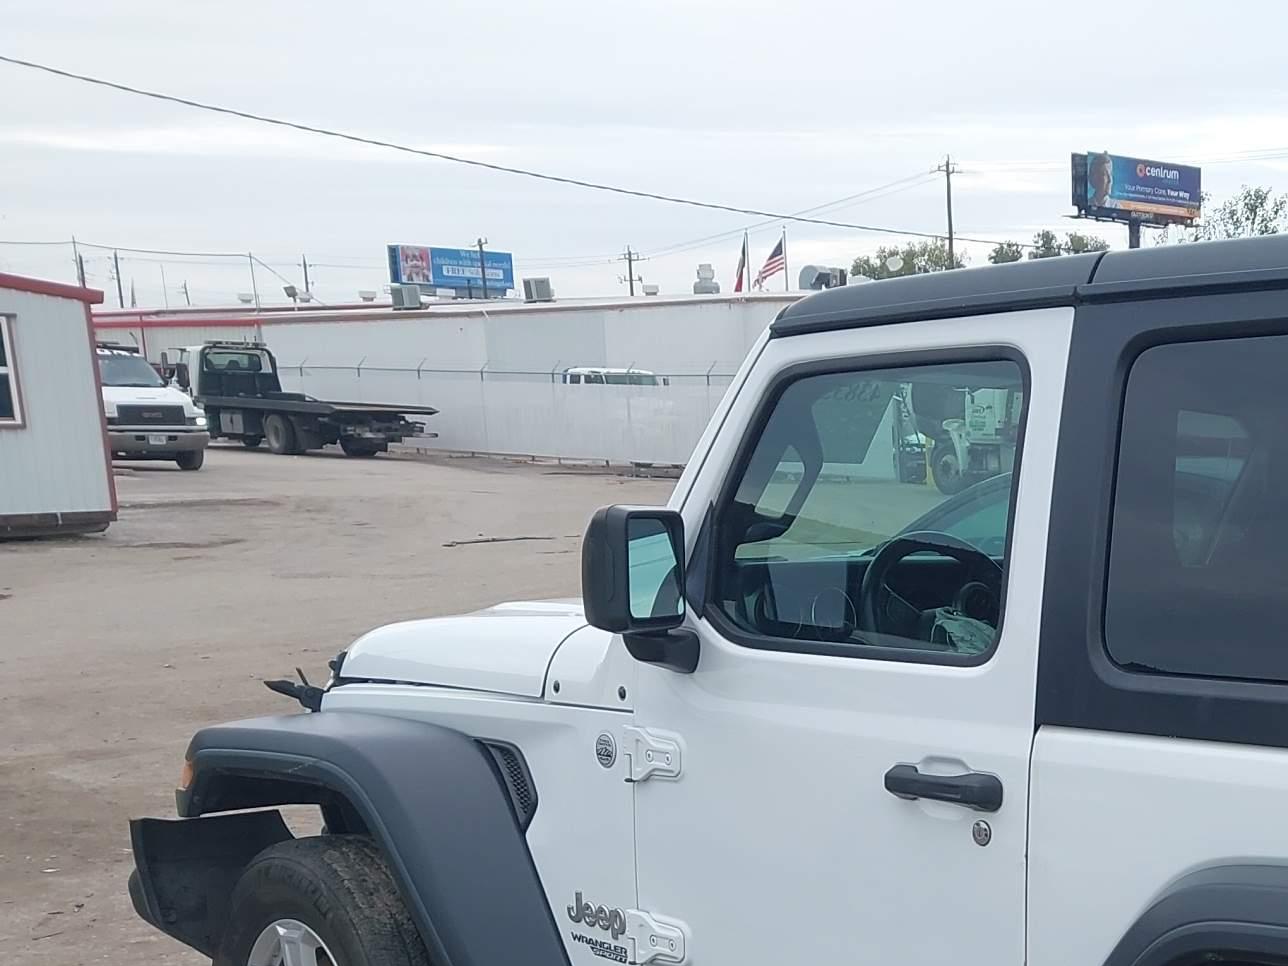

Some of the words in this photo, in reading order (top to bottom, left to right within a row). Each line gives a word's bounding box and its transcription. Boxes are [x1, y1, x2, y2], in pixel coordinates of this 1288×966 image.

[1145, 166, 1180, 179] centrum
[566, 890, 627, 941] Jeep
[570, 931, 628, 957] WRANGLER
[592, 947, 627, 964] SPORT
